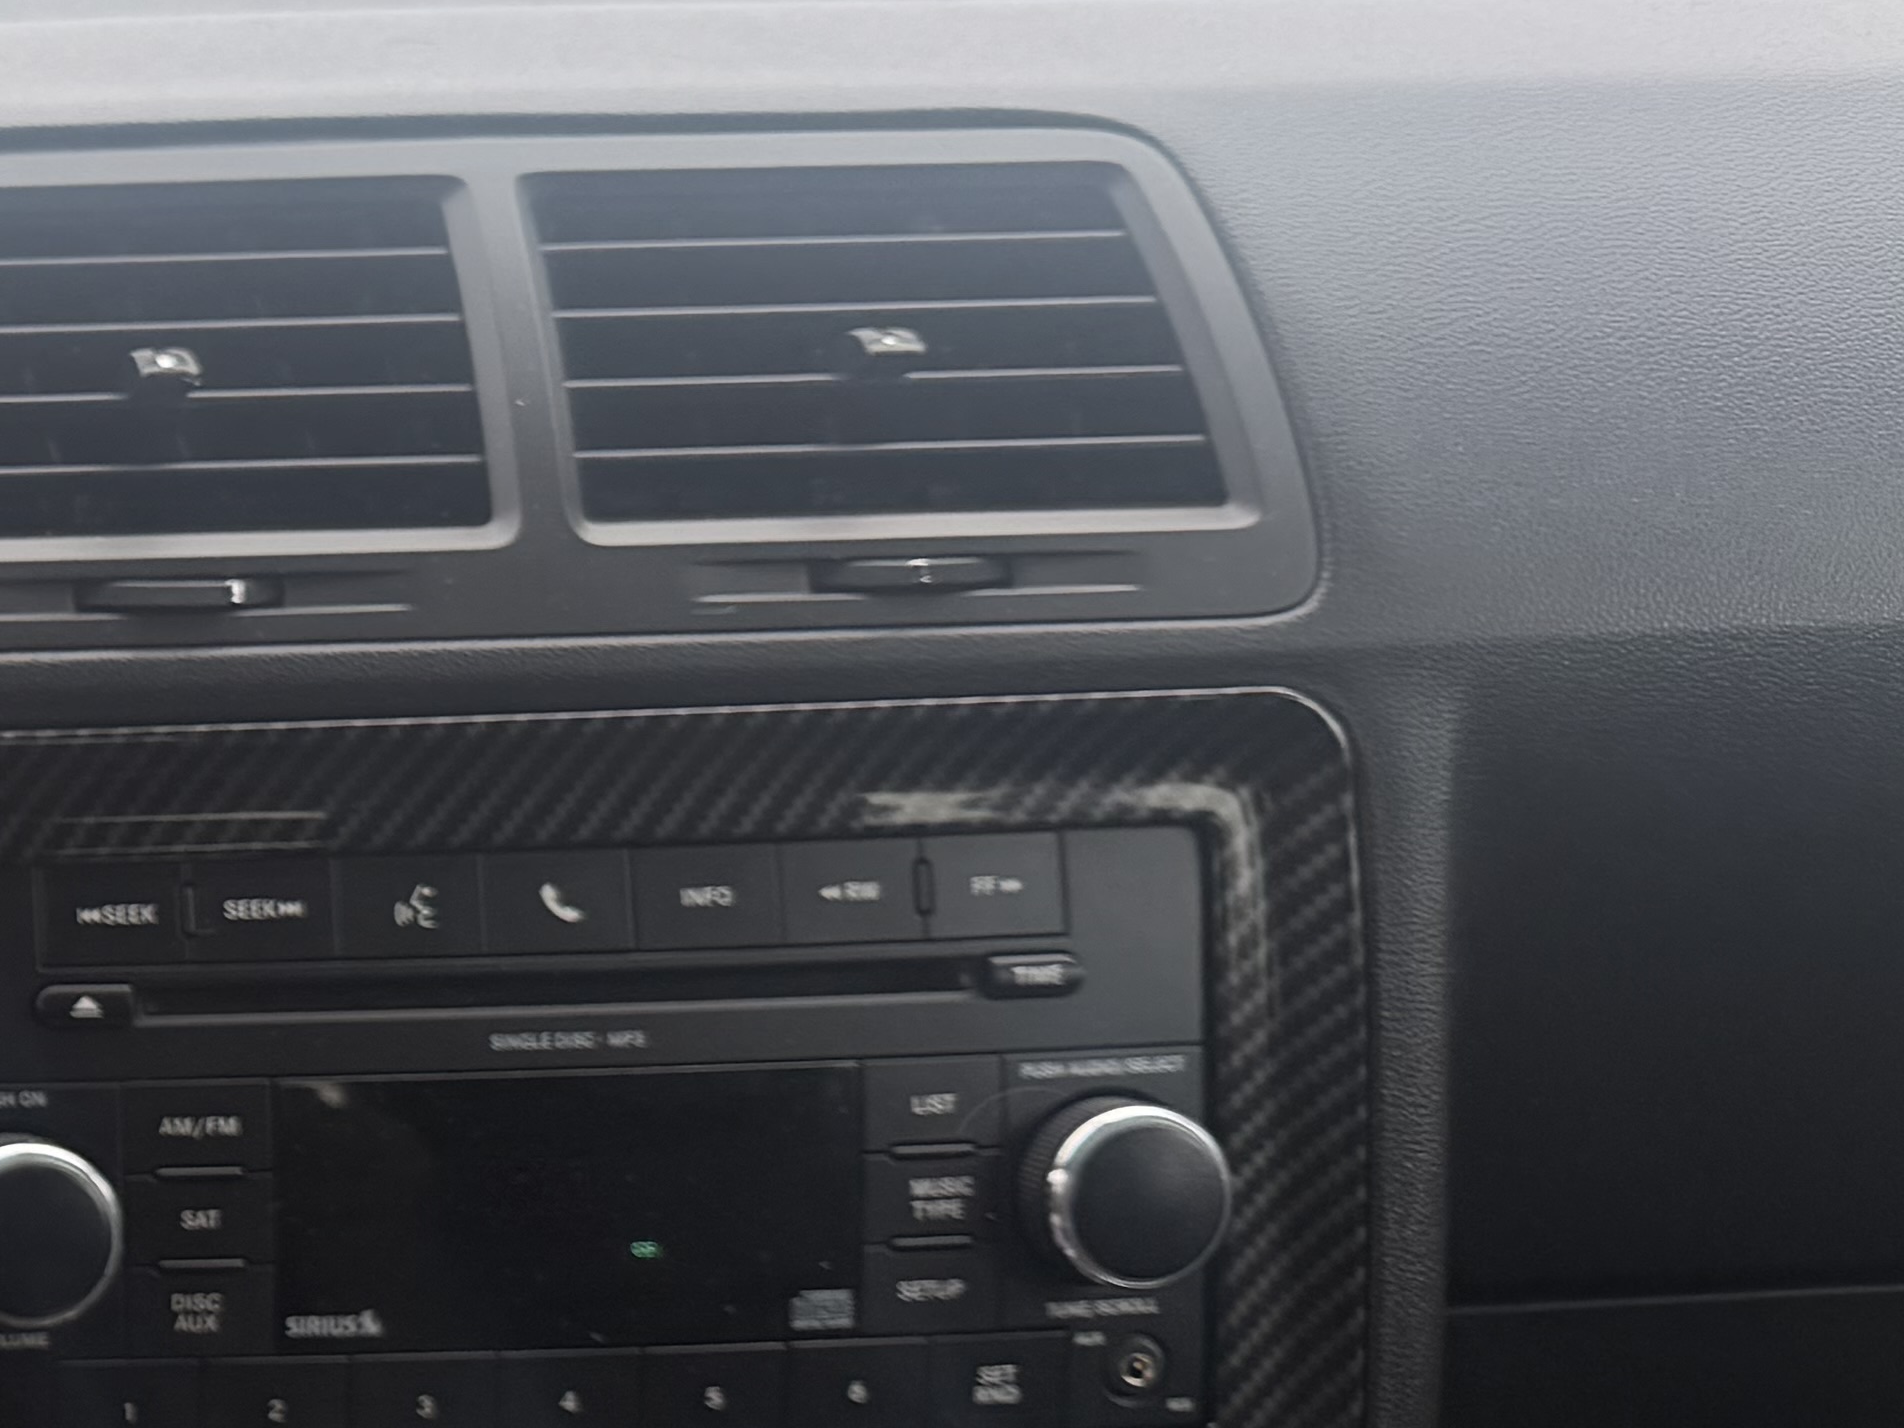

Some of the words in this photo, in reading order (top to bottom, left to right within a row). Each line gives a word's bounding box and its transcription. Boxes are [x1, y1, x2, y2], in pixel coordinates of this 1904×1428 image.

[159, 1115, 242, 1140] AM/FM
[180, 1208, 220, 1230] SAT
[266, 1398, 289, 1424] 2
[415, 1394, 438, 1419] 3
